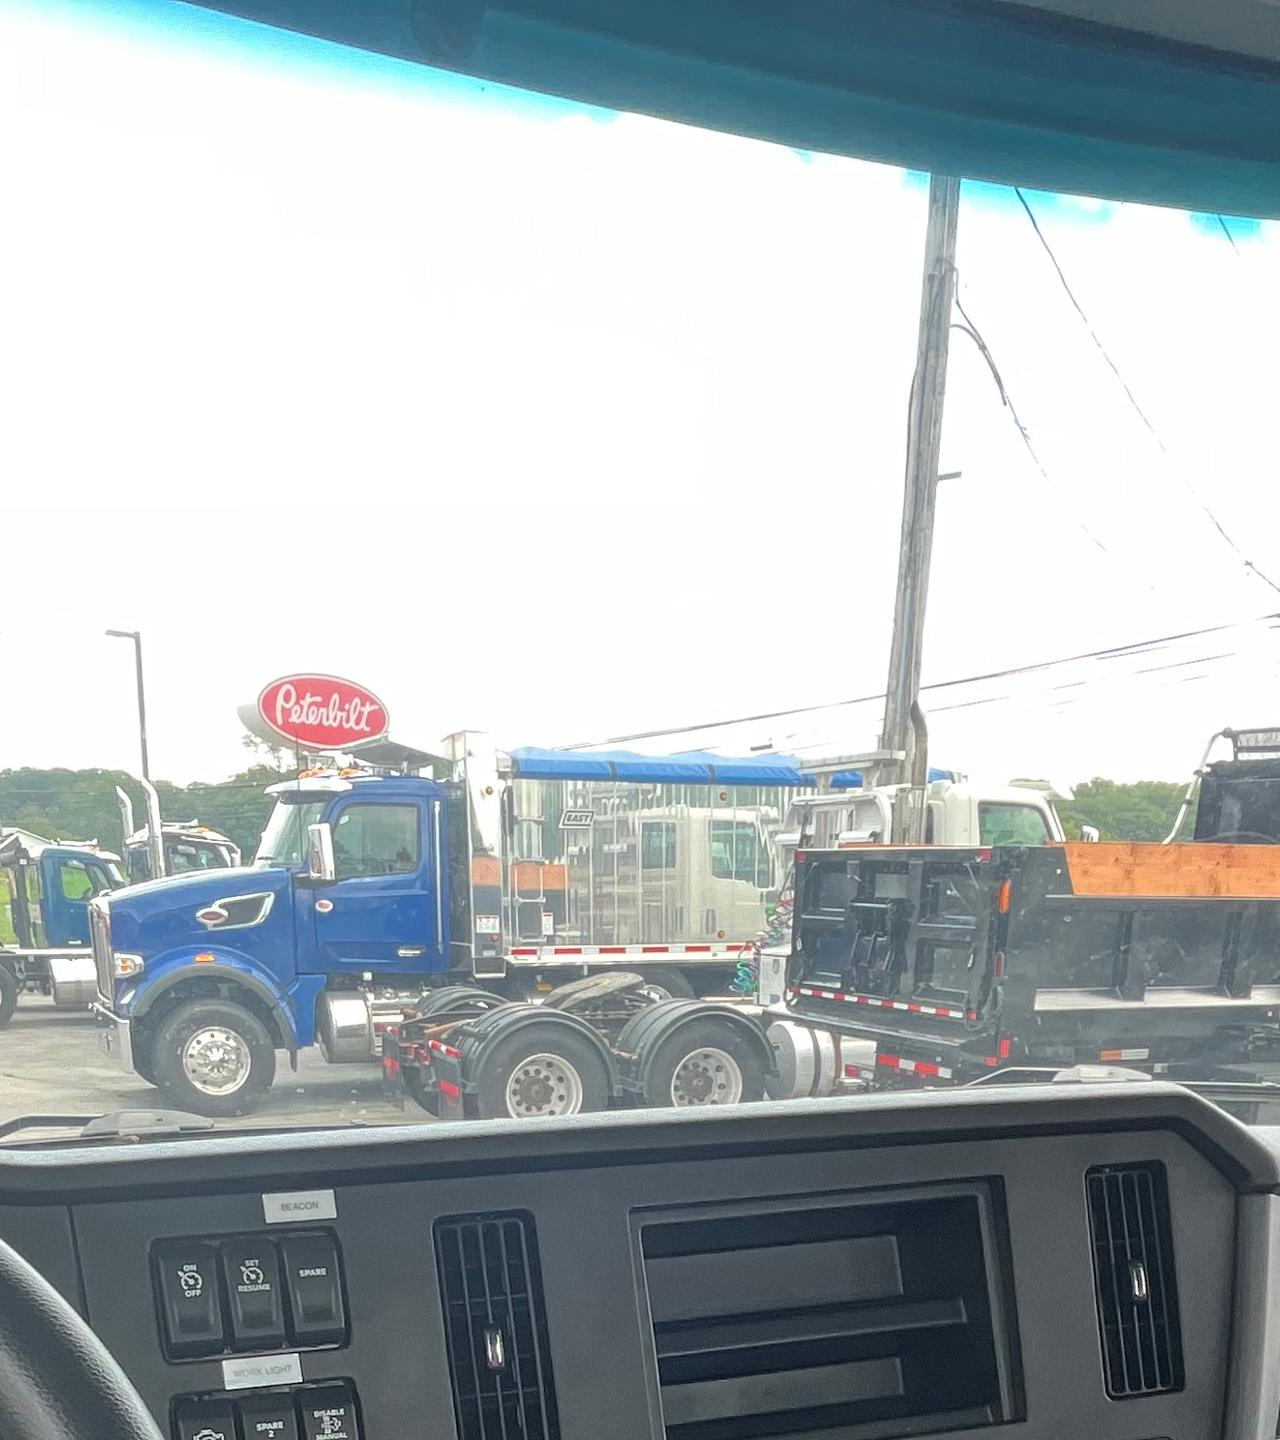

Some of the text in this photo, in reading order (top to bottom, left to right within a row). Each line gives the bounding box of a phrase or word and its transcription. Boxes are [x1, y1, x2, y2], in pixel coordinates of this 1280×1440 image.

[276, 683, 380, 732] Peterbilt
[566, 813, 590, 823] EAST
[280, 1201, 319, 1212] BEACON
[244, 1259, 260, 1267] SET
[299, 1268, 327, 1277] SPARE
[238, 1284, 270, 1292] RESUME
[185, 1290, 202, 1298] OFF
[232, 1365, 293, 1378] WORK LIGHT
[256, 1421, 284, 1431] SPARE
[268, 1430, 274, 1438] 2
